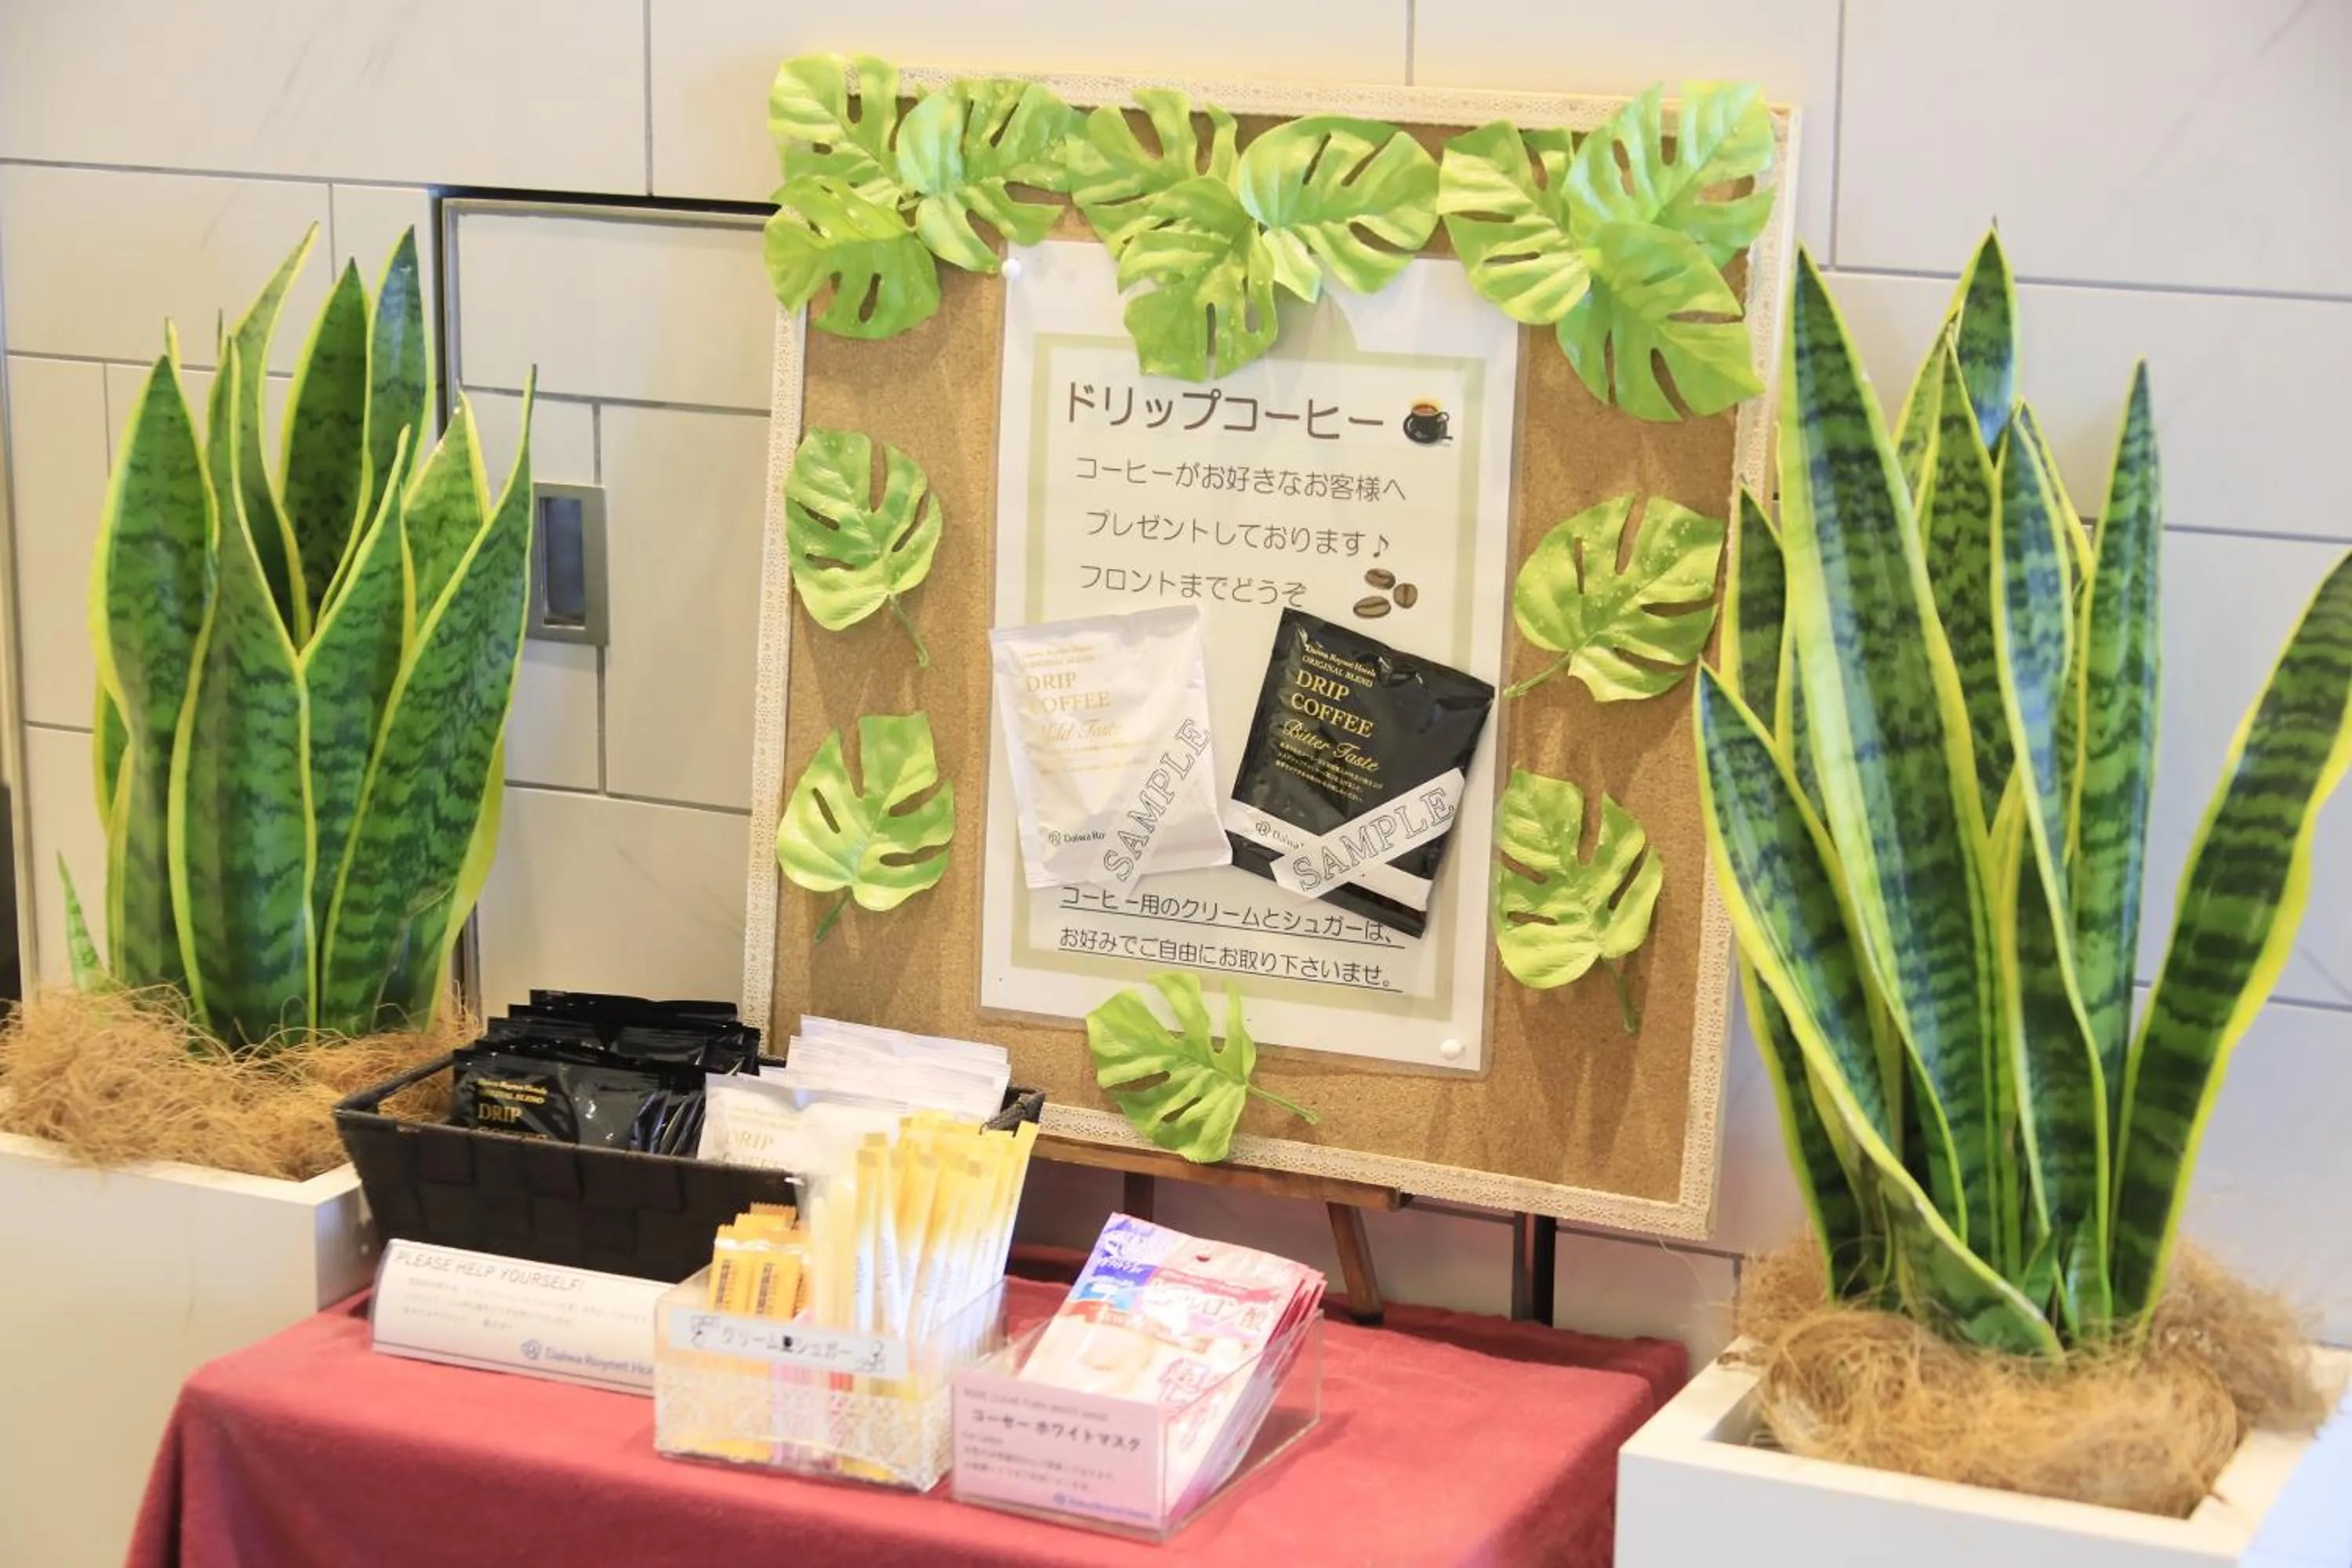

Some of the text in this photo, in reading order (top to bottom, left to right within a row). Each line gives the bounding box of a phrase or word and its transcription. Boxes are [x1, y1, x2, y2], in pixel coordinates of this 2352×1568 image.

[1069, 382, 1384, 440] ドリップコーヒー
[1076, 457, 1406, 503] コーヒーがお好きなお客様へ
[1080, 564, 1308, 610] フロントまでどうぞ
[1026, 672, 1077, 692] DRIP
[1295, 669, 1350, 701] DRIP
[1301, 655, 1373, 688] ORIGINAL BLEND
[1291, 692, 1374, 738] COFFEE
[1283, 719, 1330, 750] Bitter
[1333, 742, 1381, 772] Taste
[1104, 717, 1210, 882] SAMPLE
[1293, 786, 1455, 891] SAMPLE
[1059, 927, 1390, 987] お好みでご自由にお取り下さいませ。
[477, 1102, 522, 1123] DRIP
[394, 1250, 452, 1273] PLEASE
[454, 1261, 494, 1278] HELP
